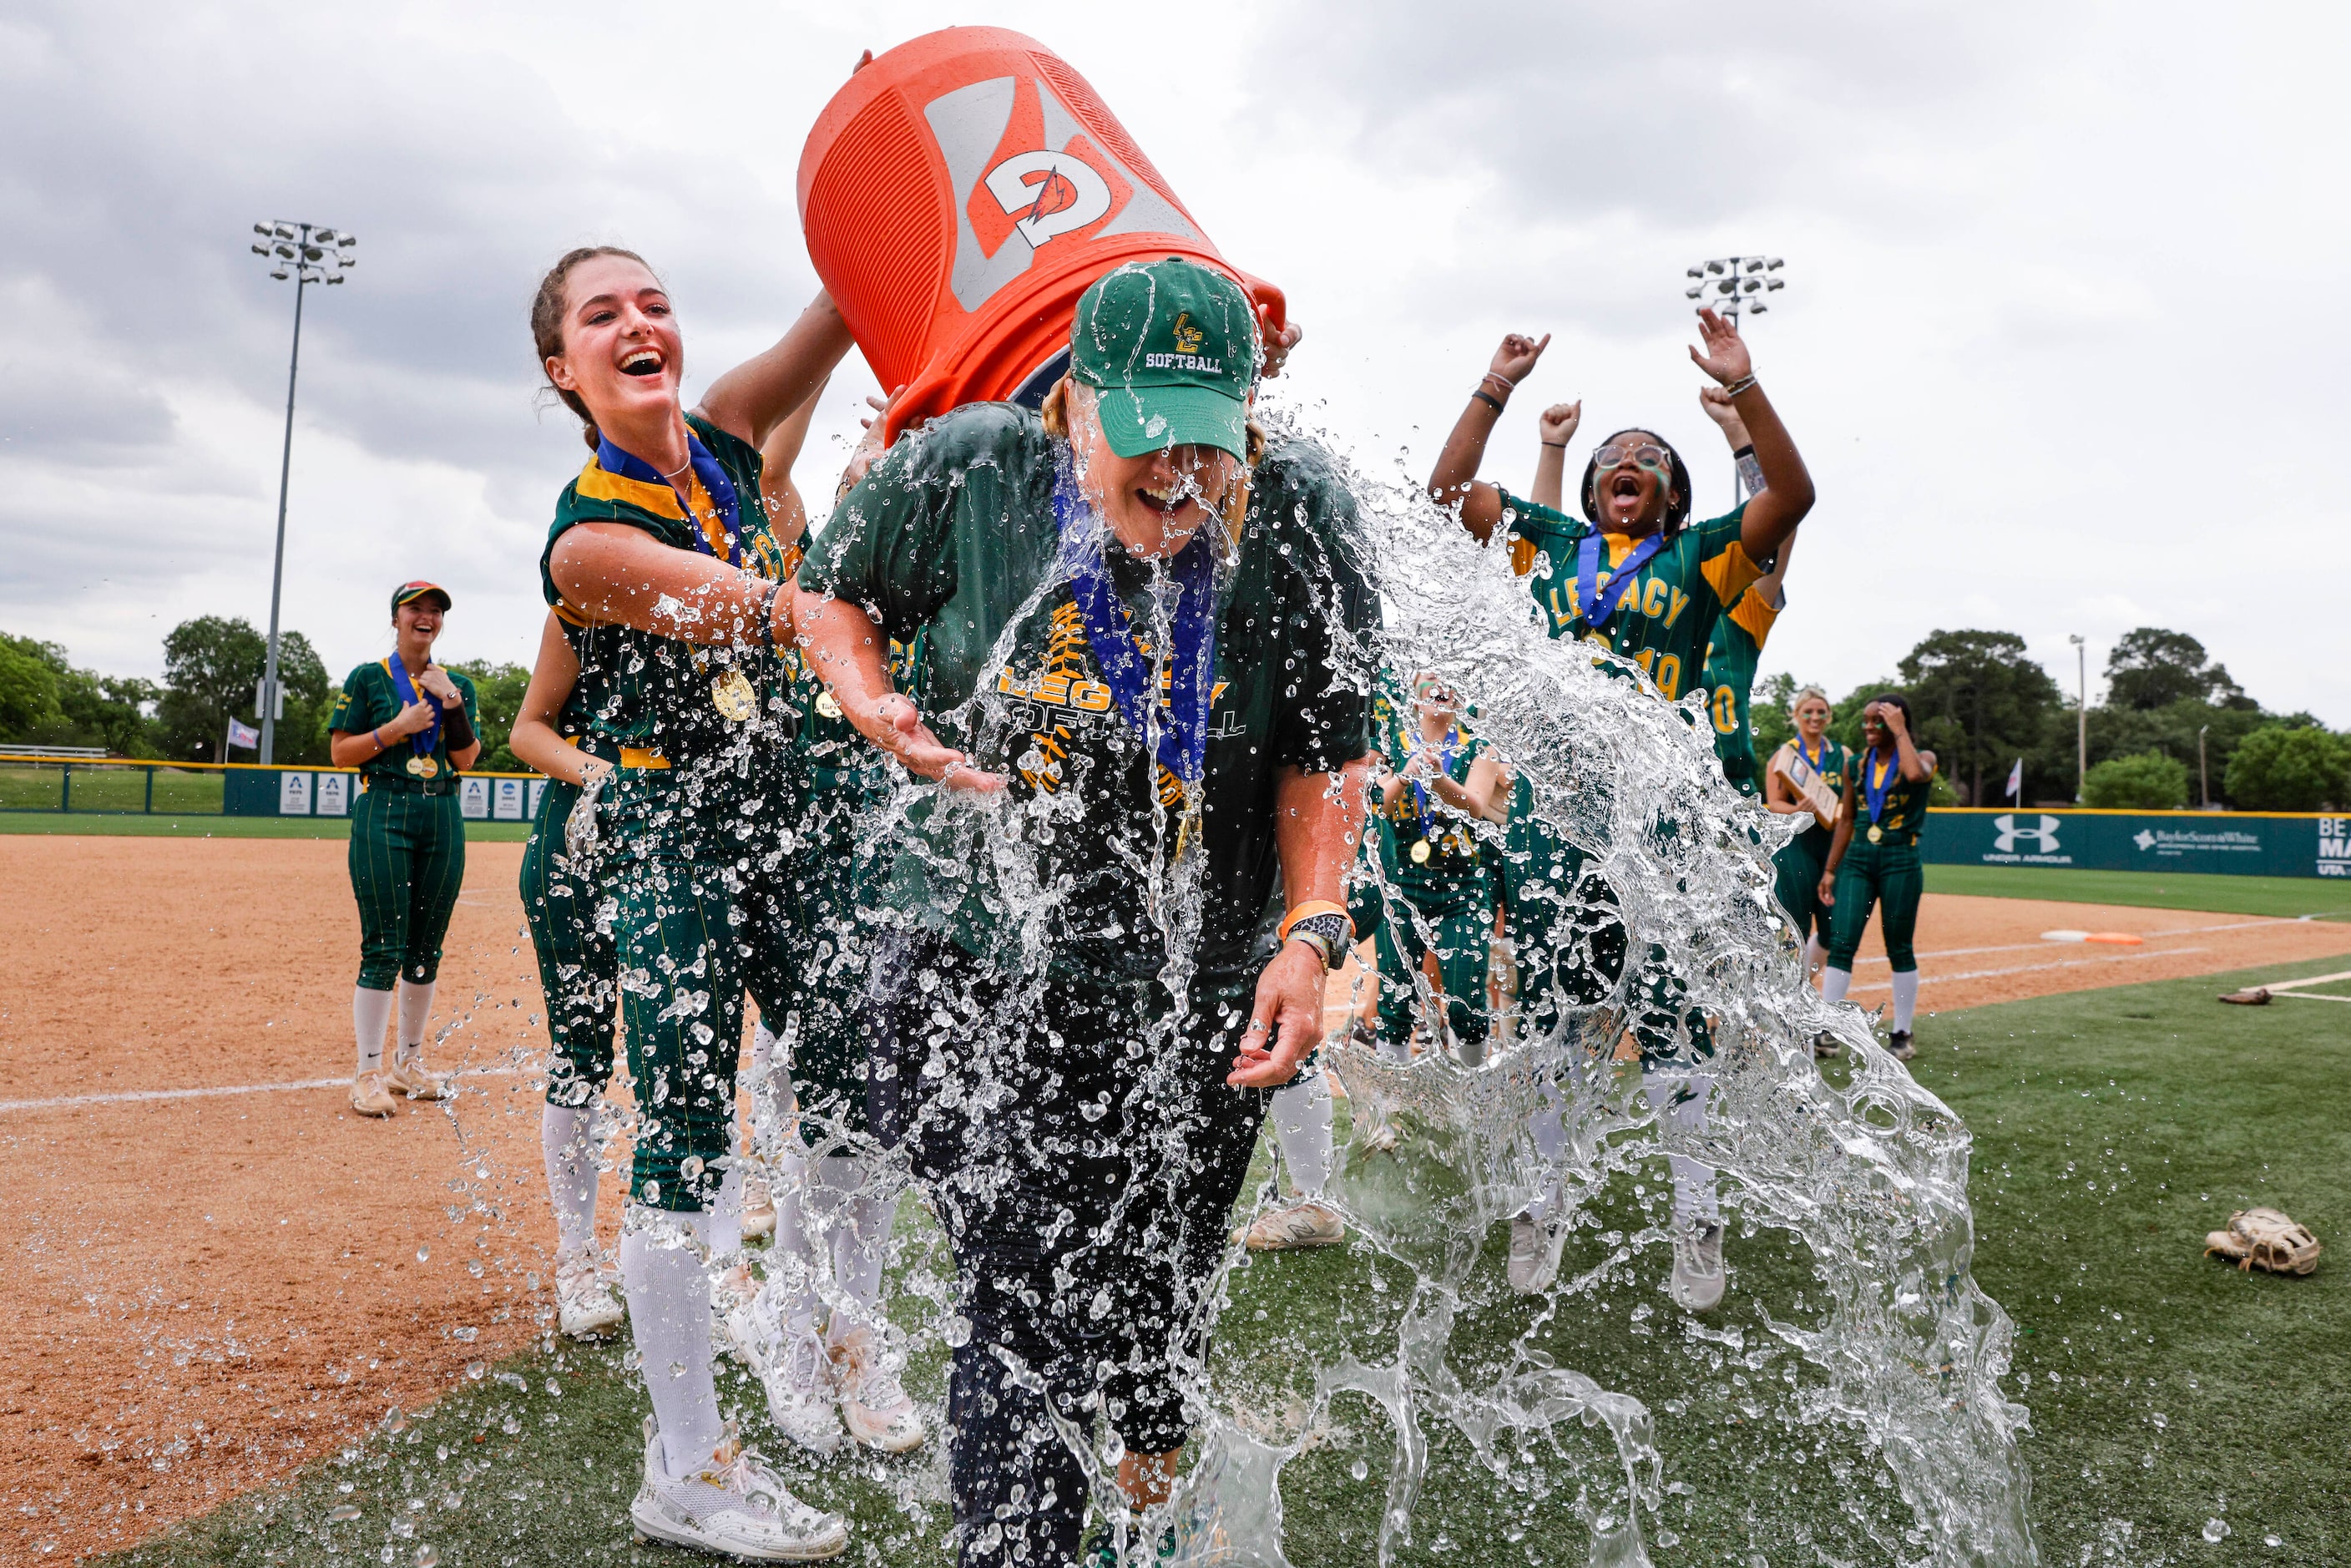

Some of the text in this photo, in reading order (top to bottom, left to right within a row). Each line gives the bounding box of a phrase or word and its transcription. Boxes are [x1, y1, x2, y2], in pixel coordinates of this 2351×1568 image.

[1145, 352, 1222, 374] SOFTBALL
[1633, 646, 1681, 702] 19
[2319, 817, 2346, 837] BE
